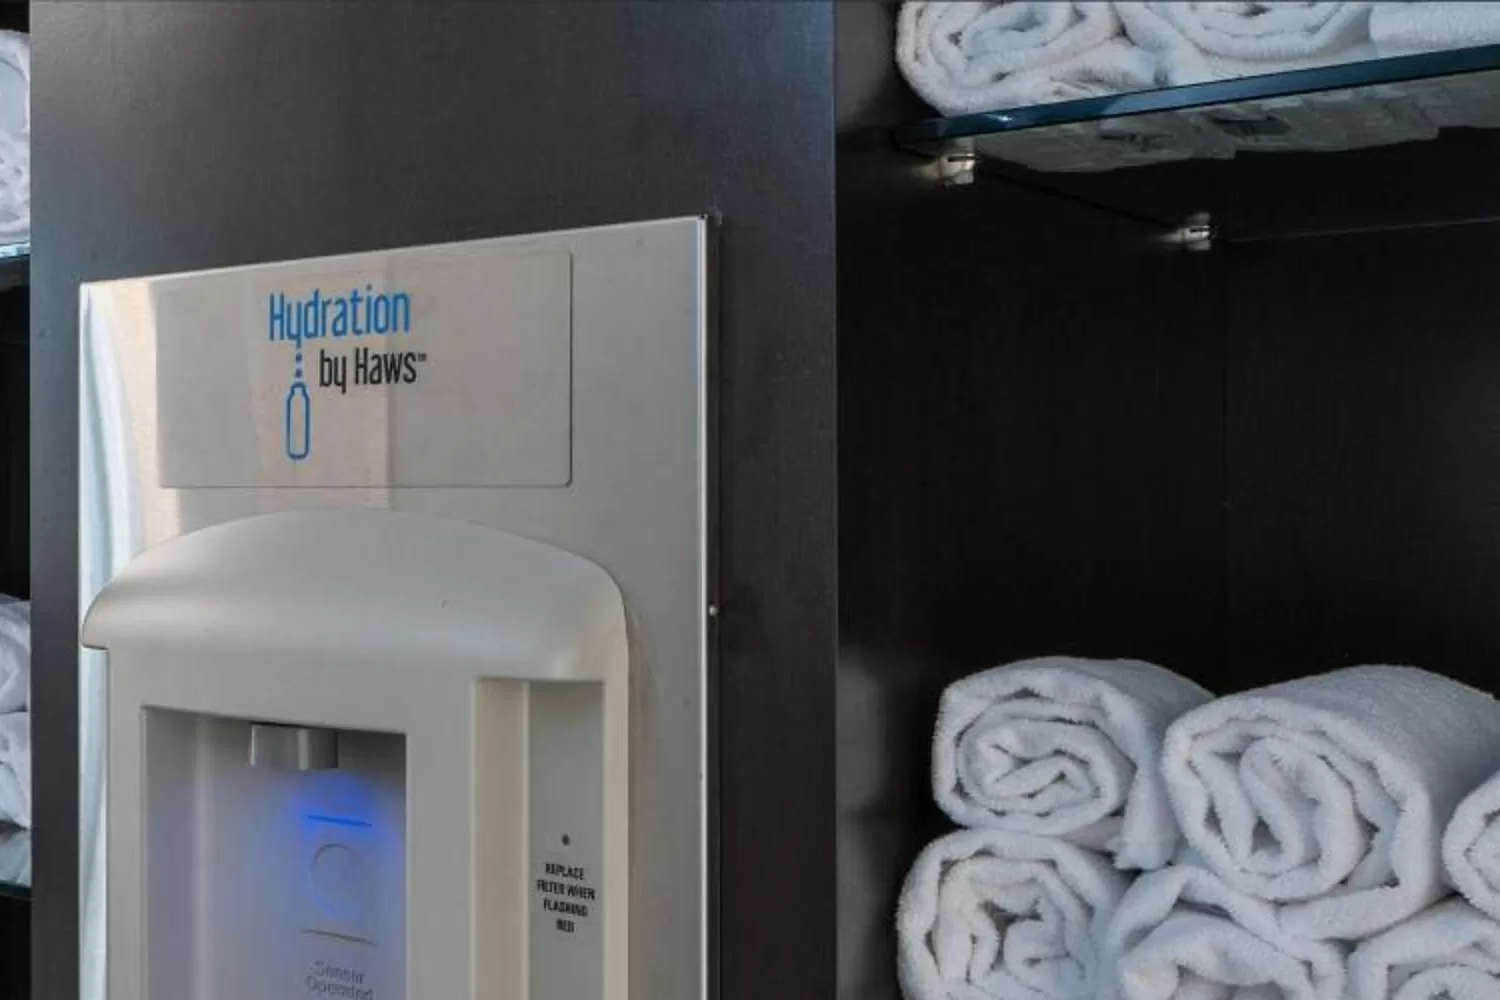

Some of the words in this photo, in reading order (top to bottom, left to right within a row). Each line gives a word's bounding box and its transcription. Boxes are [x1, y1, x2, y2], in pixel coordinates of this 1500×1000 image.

[268, 283, 411, 348] Hydration
[318, 348, 347, 395] by
[544, 862, 585, 880] REPLACE
[536, 879, 566, 895] FILTER
[567, 885, 596, 901] WHEN
[543, 898, 589, 918] FLASHING
[555, 918, 576, 933] RED
